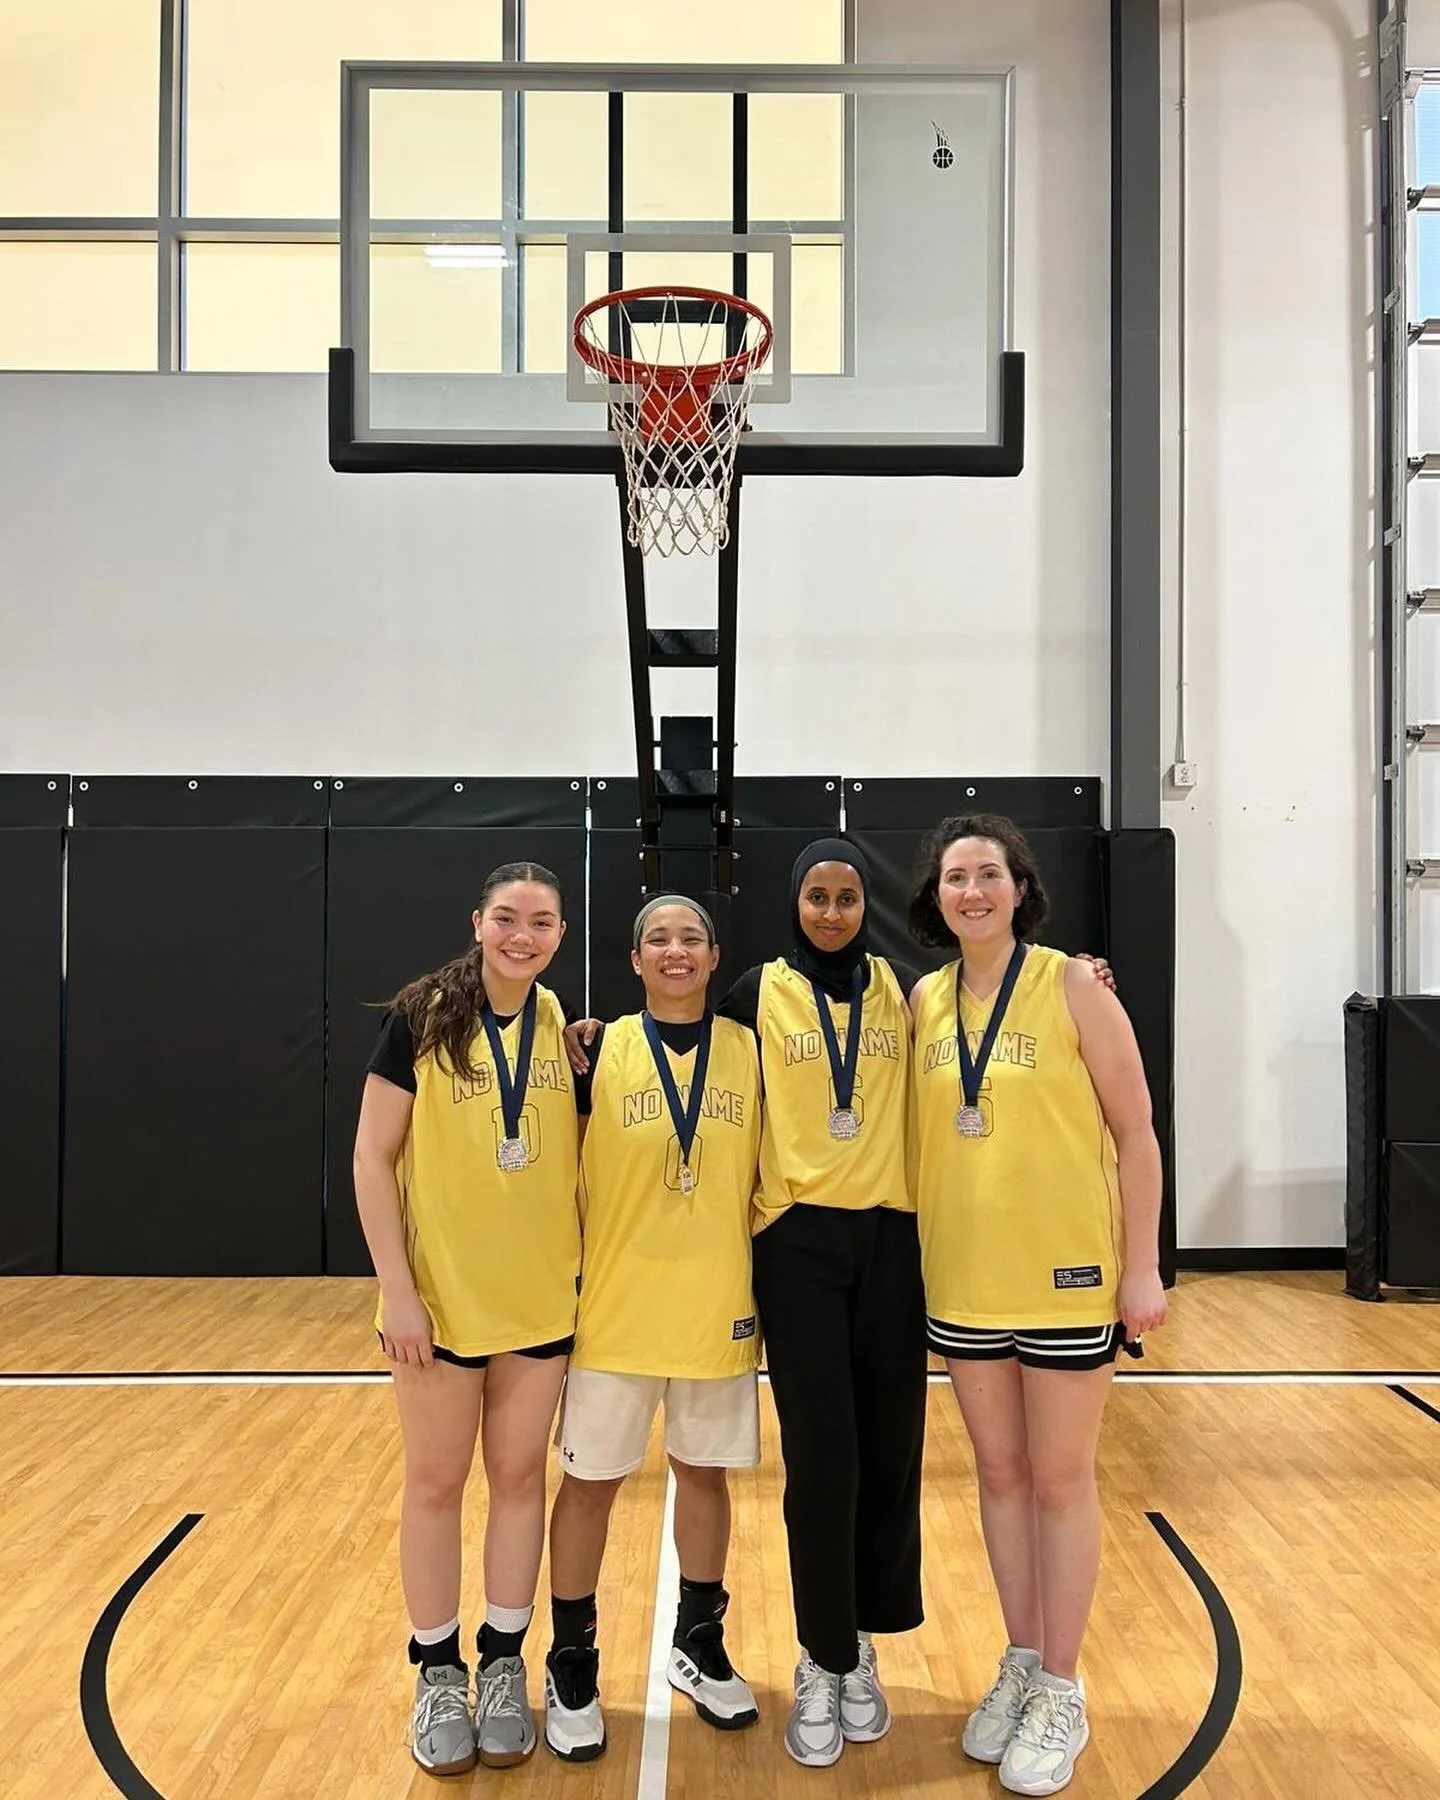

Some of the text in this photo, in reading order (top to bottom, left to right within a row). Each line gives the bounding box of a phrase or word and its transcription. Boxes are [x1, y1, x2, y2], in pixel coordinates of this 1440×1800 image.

[784, 1027, 900, 1067] NO ME
[923, 1034, 959, 1075] NO
[452, 1057, 569, 1104] NO ME
[623, 1087, 662, 1128] NO
